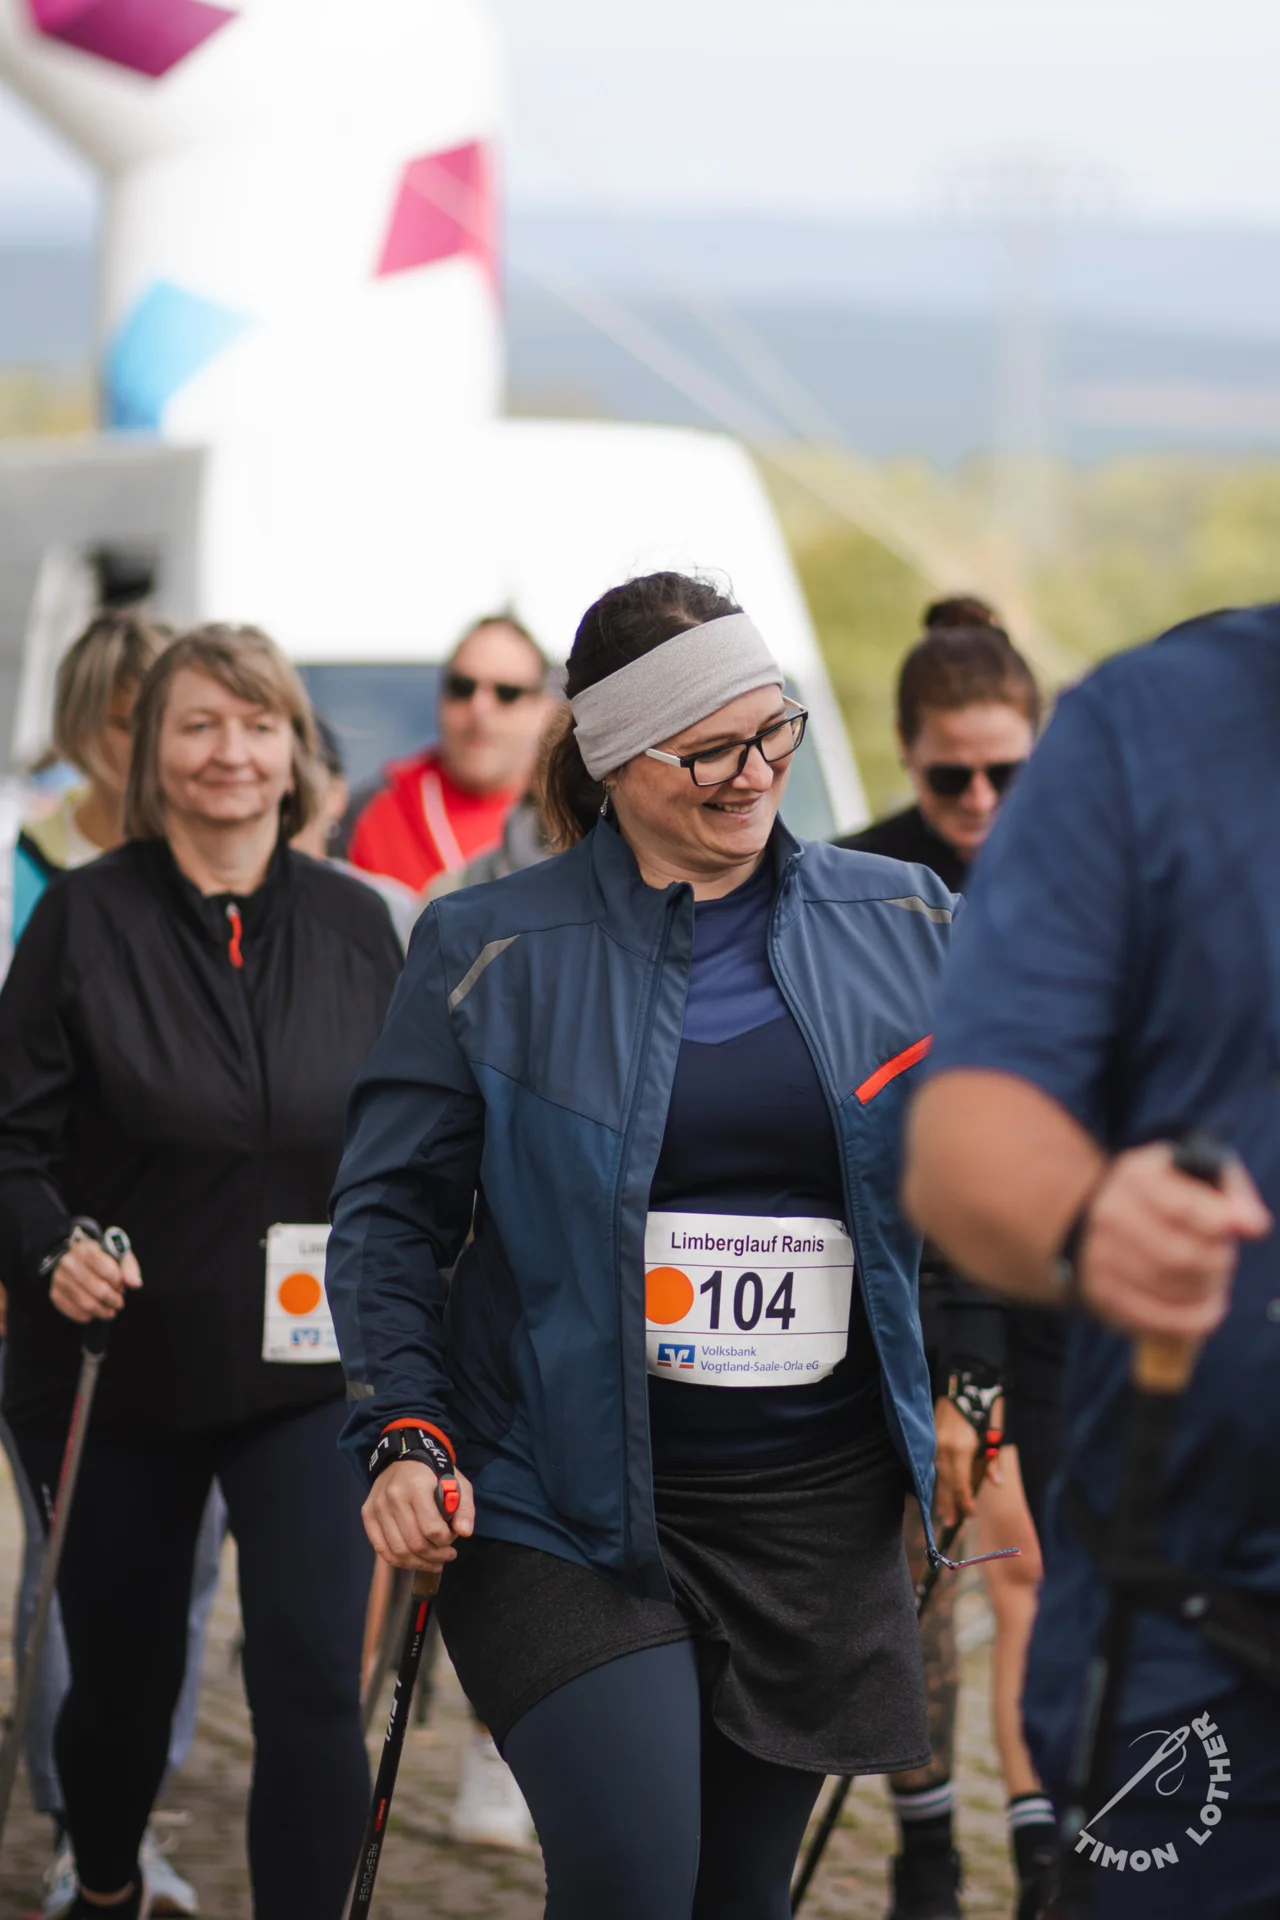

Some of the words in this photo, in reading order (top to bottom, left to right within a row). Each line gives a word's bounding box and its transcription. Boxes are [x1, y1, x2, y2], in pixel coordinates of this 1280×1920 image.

[670, 1231, 778, 1257] Limberglauf
[781, 1236, 825, 1253] Ranis
[699, 1270, 796, 1331] 104
[701, 1346, 757, 1357] Volksbank
[700, 1361, 803, 1374] Vogtland-Saale-Orla
[805, 1361, 819, 1371] eG
[359, 1843, 379, 1901] RESPONSE
